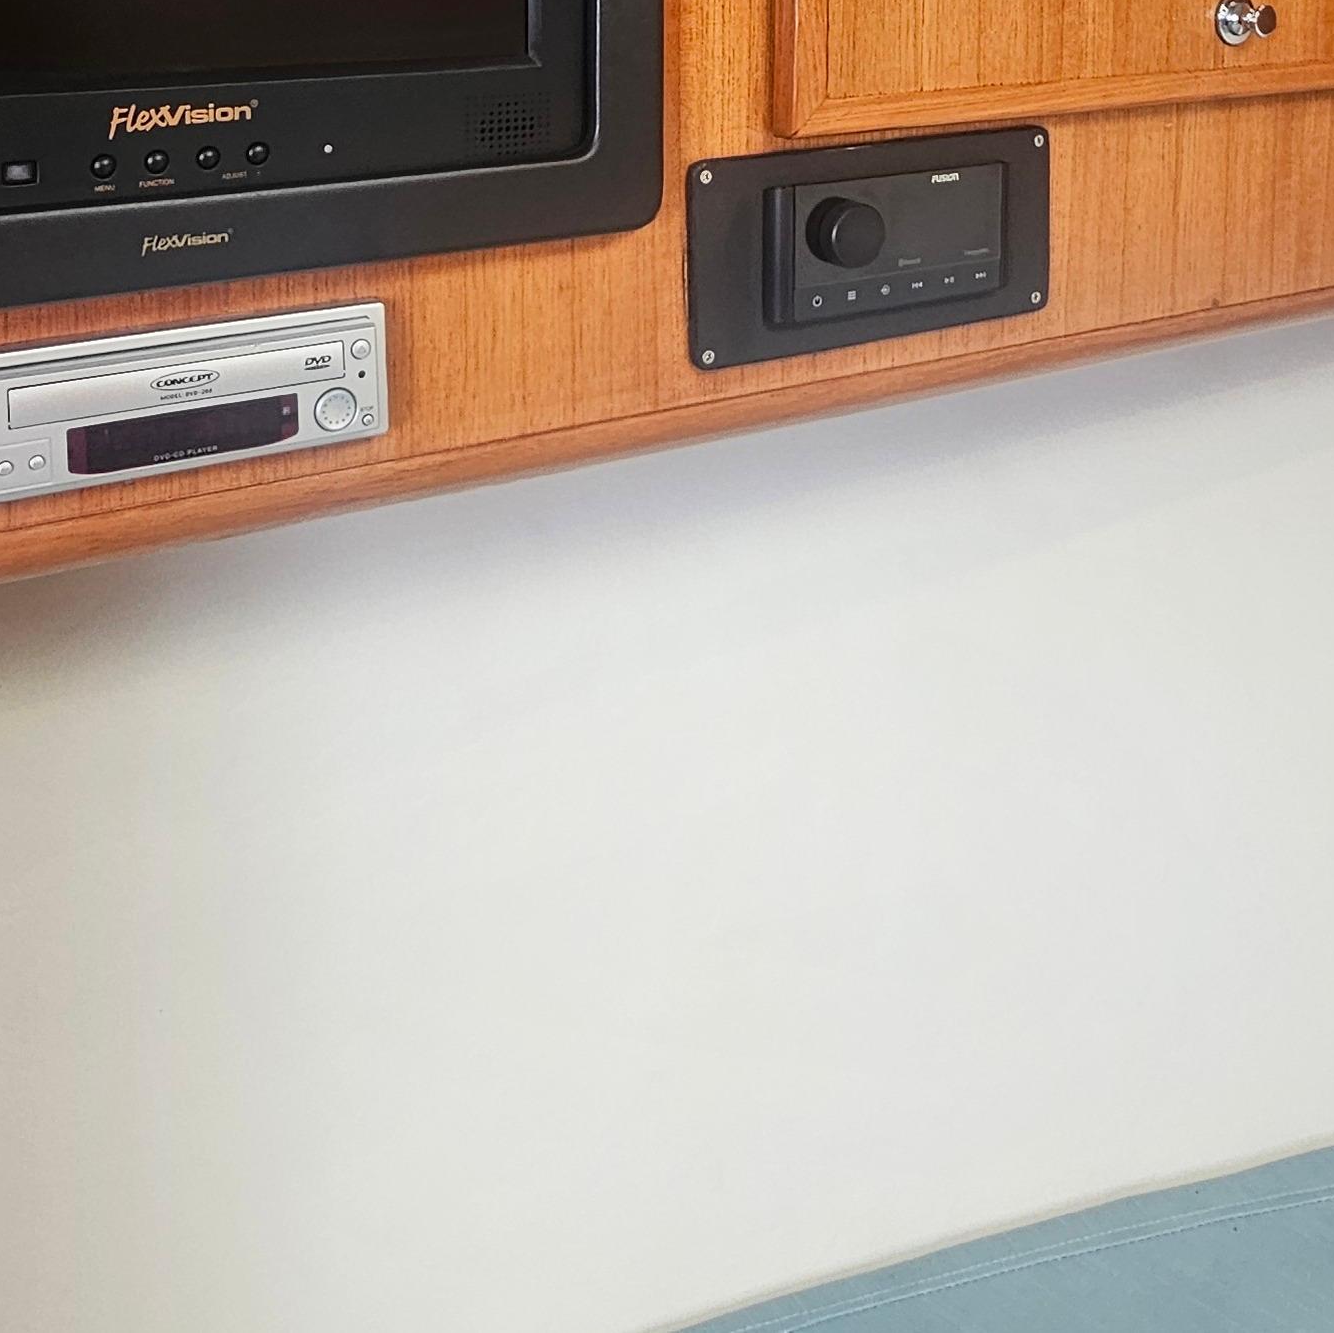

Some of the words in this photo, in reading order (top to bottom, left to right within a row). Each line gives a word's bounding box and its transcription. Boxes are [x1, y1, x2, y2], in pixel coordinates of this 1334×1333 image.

[108, 103, 253, 141] FlexVision
[138, 178, 175, 188] FUNCTION
[931, 172, 960, 184] FUSION
[94, 184, 116, 193] MENU
[141, 231, 230, 257] FlexVision
[304, 355, 332, 367] DVD
[156, 372, 214, 388] CONCEPT
